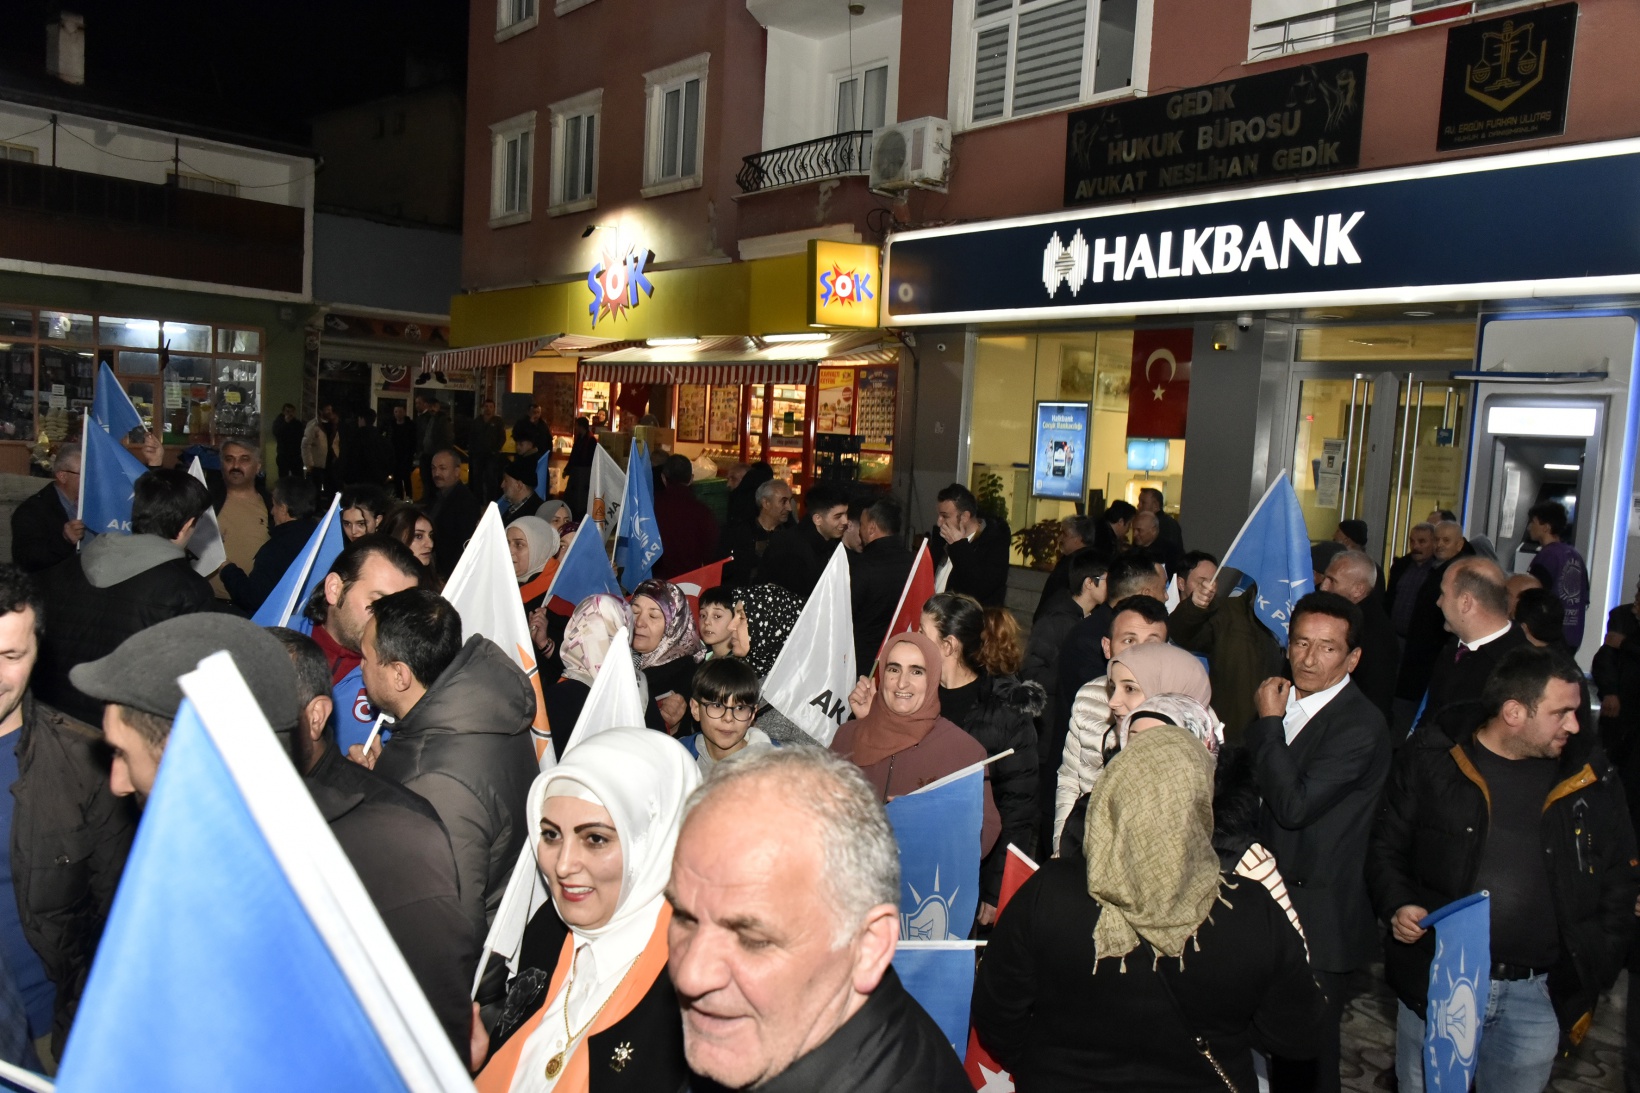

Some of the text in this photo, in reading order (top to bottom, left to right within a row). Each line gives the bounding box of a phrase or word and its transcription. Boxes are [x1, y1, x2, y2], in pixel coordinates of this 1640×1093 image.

[1167, 86, 1236, 121] GEDİK
[1108, 109, 1302, 165] HUKUK BÜROSU
[1076, 139, 1341, 199] AVUKAT NESLİHAN GEDİK
[1093, 211, 1365, 283] HALKBANK
[587, 246, 655, 330] ŞOK
[820, 271, 875, 308] ŞOK
[107, 518, 132, 531] AK
[809, 689, 846, 726] AK
